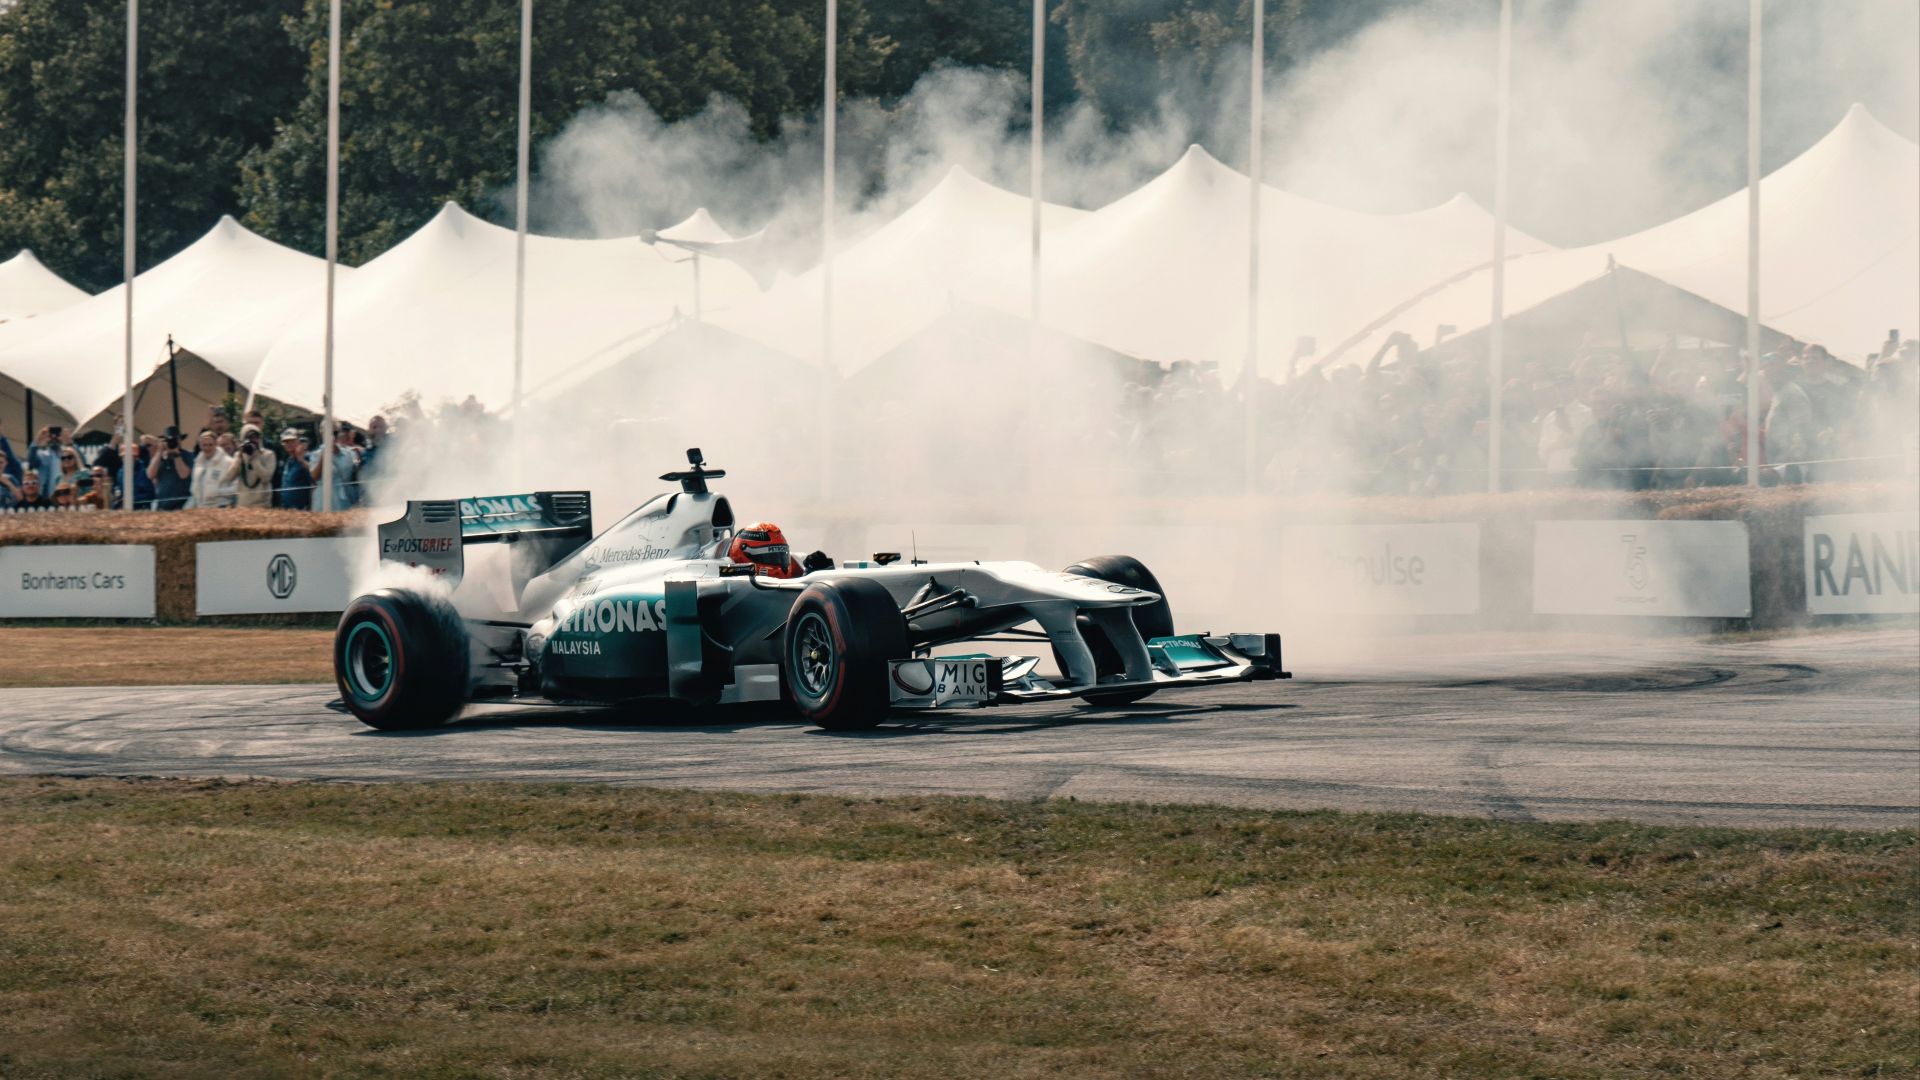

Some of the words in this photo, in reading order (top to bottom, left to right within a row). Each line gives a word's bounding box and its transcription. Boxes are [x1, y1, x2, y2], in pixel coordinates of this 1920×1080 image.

[600, 545, 670, 563] Mercedes-Benz
[22, 571, 87, 590] Bonhams
[92, 572, 125, 590] Cars
[268, 555, 296, 597] MG
[560, 600, 667, 632] ETRONAS
[552, 640, 601, 655] MALAYSIA
[941, 664, 985, 683] MIG
[937, 683, 987, 695] BANK
